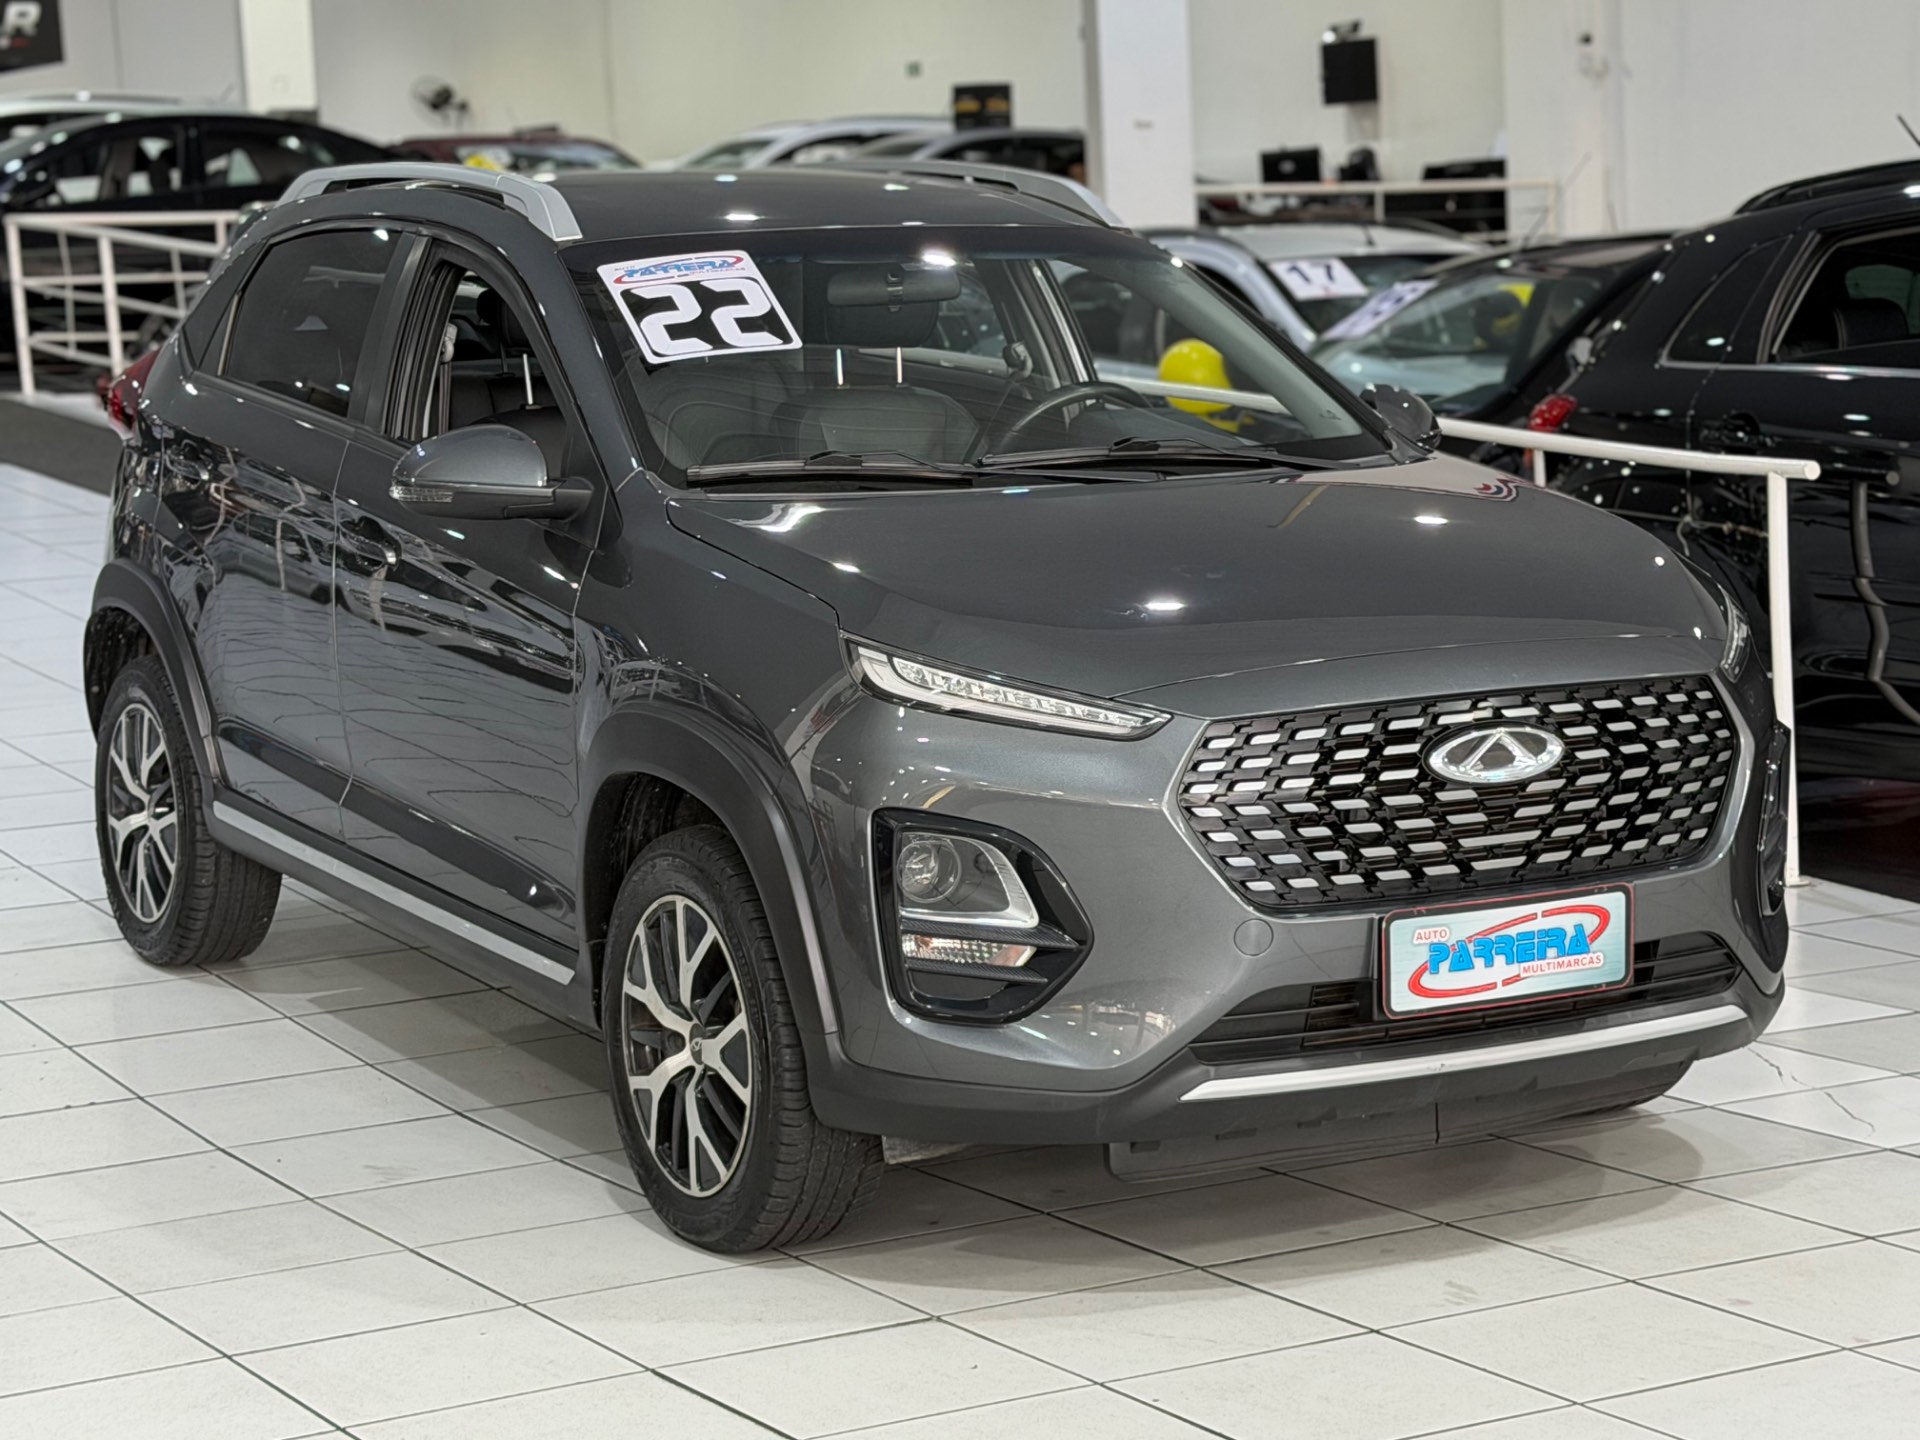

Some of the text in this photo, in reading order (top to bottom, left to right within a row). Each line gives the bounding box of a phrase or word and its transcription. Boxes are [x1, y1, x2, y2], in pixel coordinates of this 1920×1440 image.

[630, 278, 784, 355] 22
[1416, 929, 1447, 942] AUTO
[1429, 924, 1590, 974] PARREIRA
[1522, 956, 1602, 976] MULTIMARCAS
